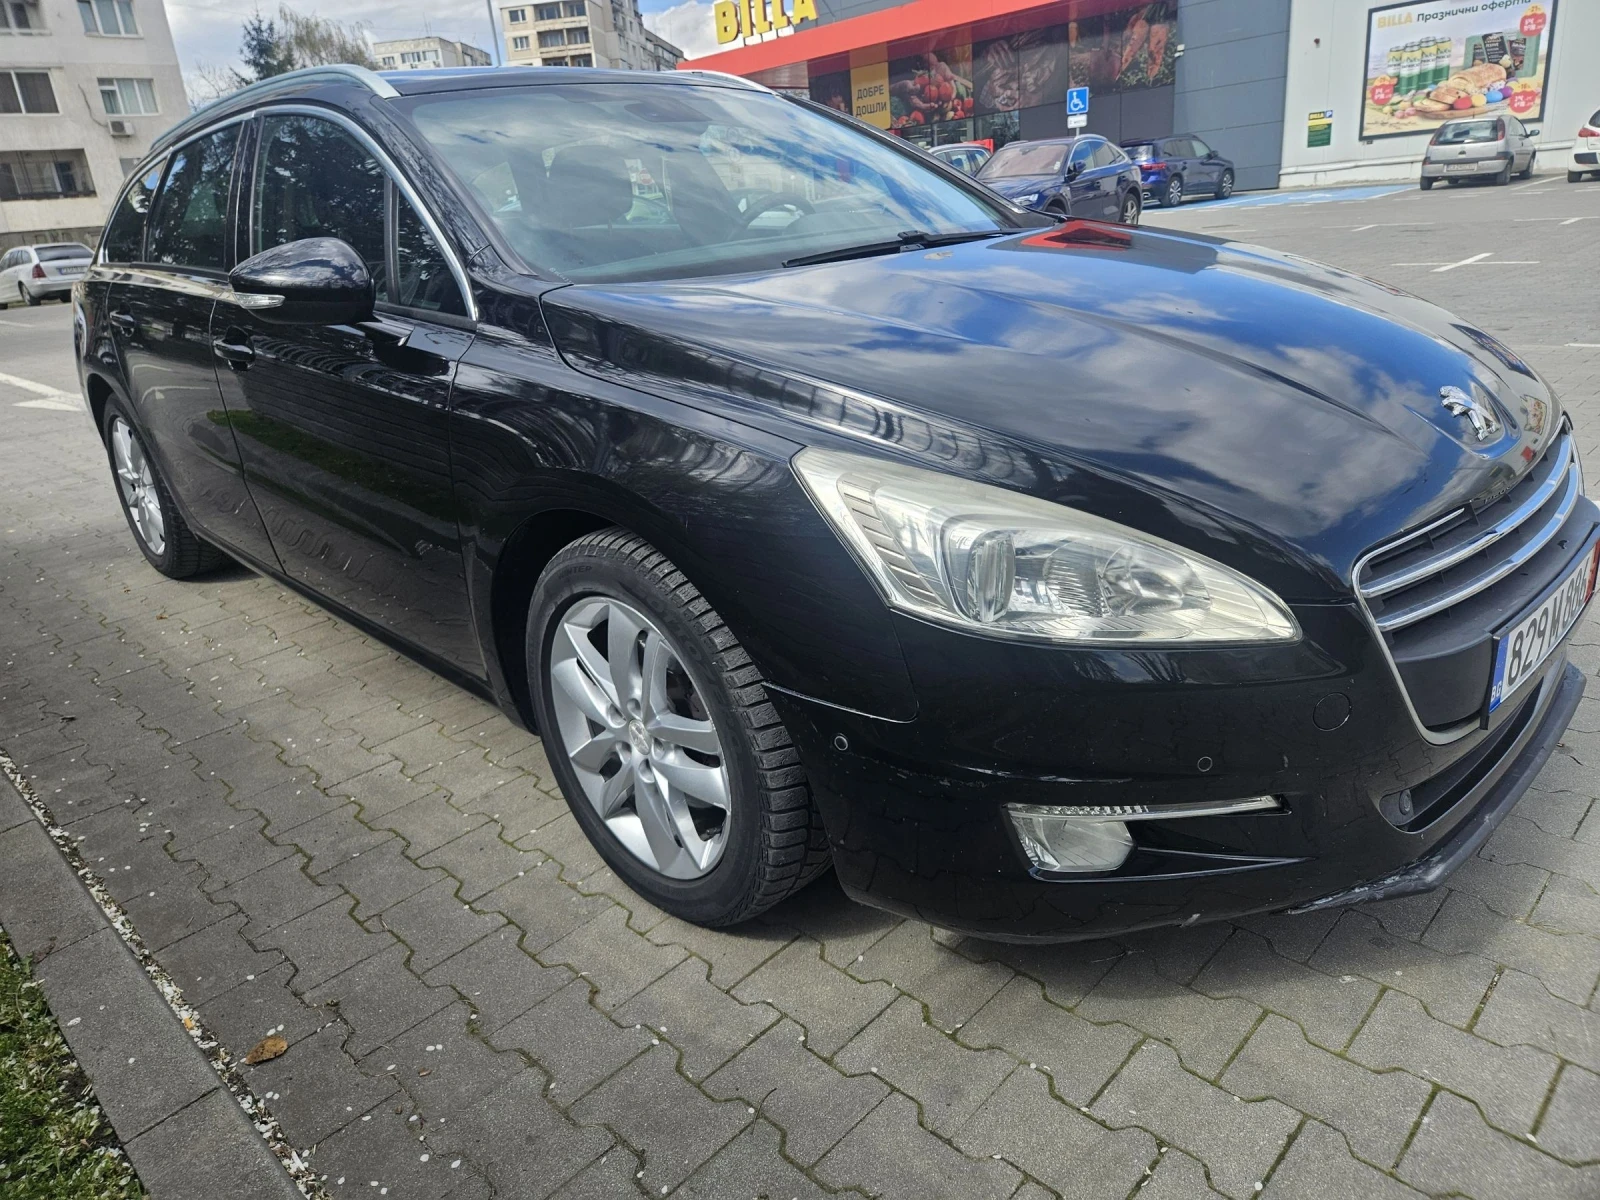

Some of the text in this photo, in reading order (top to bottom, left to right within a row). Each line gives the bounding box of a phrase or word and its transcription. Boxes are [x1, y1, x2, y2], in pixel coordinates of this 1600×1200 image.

[714, 0, 819, 44] BILLA
[1377, 12, 1413, 28] BILLA
[1417, 5, 1479, 23] Празнични
[856, 84, 885, 101] ДОБРЕ
[855, 101, 887, 118] ДОШЛИ
[1507, 606, 1549, 687] 829
[1548, 587, 1565, 648] M
[1491, 680, 1502, 703] BG
